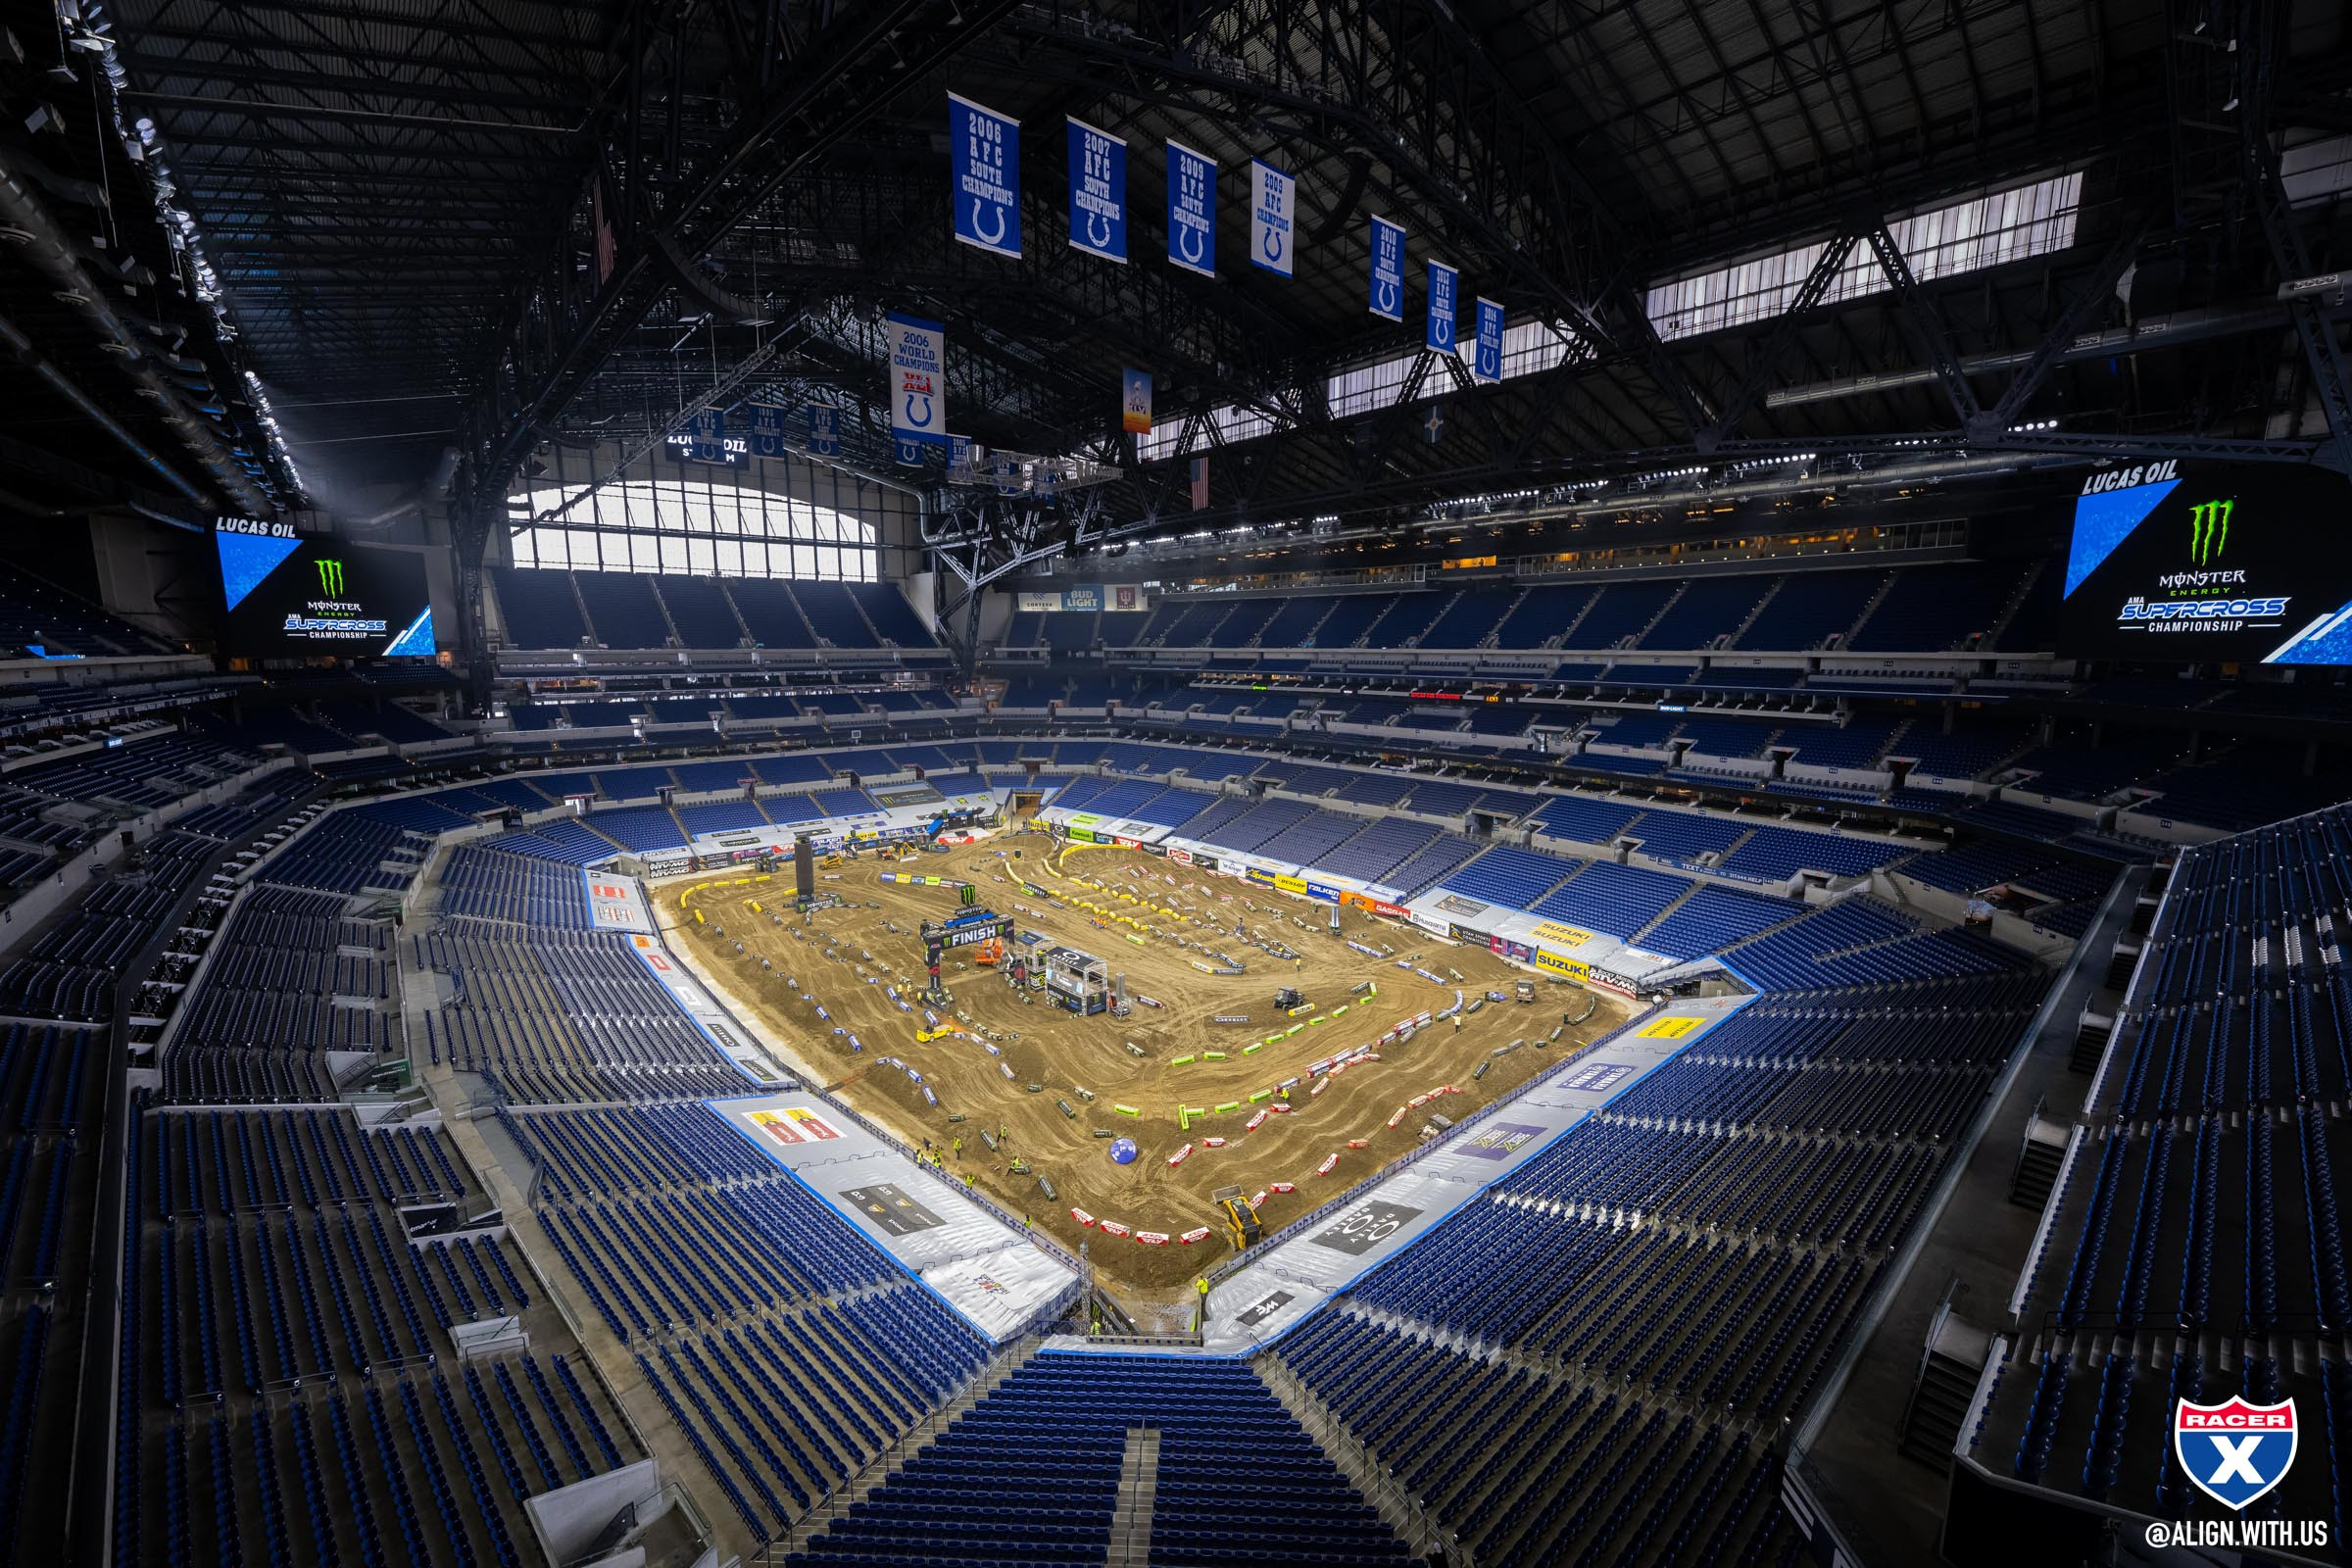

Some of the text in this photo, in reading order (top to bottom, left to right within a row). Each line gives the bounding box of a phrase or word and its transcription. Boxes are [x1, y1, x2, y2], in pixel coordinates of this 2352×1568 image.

[969, 113, 1001, 143] 2006
[969, 136, 1002, 167] AFC
[1085, 132, 1109, 157] 2007
[971, 159, 1002, 185] SOUTH
[1085, 151, 1109, 180] AFC
[1181, 155, 1203, 180] 2009
[962, 175, 1013, 206] CHAMPIONS
[1085, 175, 1109, 200] SOUTH
[1182, 174, 1203, 200] AFC
[1265, 172, 1283, 194] 2009
[1076, 190, 1119, 220] CHAMPIONS
[1182, 193, 1202, 216] SOUTH
[1265, 192, 1281, 213] AFC
[1174, 206, 1209, 234] CHAMPIONS
[1257, 208, 1289, 232] CHAMPIONS
[1381, 226, 1396, 245] 2010
[1381, 241, 1396, 260] AFC
[1381, 257, 1395, 272] SOUTH
[1375, 267, 1399, 287] CHAMPIONS
[1437, 283, 1449, 299] AFC
[904, 331, 929, 347] 2006
[899, 344, 935, 361] WORLD
[894, 355, 940, 373] CHAMPIONS
[724, 439, 747, 453] OIL
[2082, 460, 2178, 496] LUCAS OIL
[216, 516, 295, 538] LUCAS OIL
[2159, 569, 2246, 588] MONSTER
[2170, 587, 2230, 597] ENERGY
[307, 601, 362, 612] MONSTER
[1066, 599, 1098, 608] LIGHT
[2117, 597, 2292, 620] SUPERCROSS
[283, 618, 387, 630] SUPERCROSS
[2148, 621, 2243, 632] CHAMPIONSHIP
[1682, 863, 1699, 872] TEXT
[1308, 885, 1340, 897] FALKEN
[1376, 905, 1409, 919] GASGAS
[1418, 917, 1446, 931] Husqvarna
[1544, 923, 1591, 940] SUZUKI
[953, 925, 996, 947] FINISH
[1533, 931, 1580, 947] SUZUKI
[1539, 955, 1588, 976] SUZUKI
[1294, 1005, 1313, 1014] SUZUKI
[1326, 1207, 1370, 1236] OAKLEY
[1350, 1213, 1396, 1243] OAKLEY
